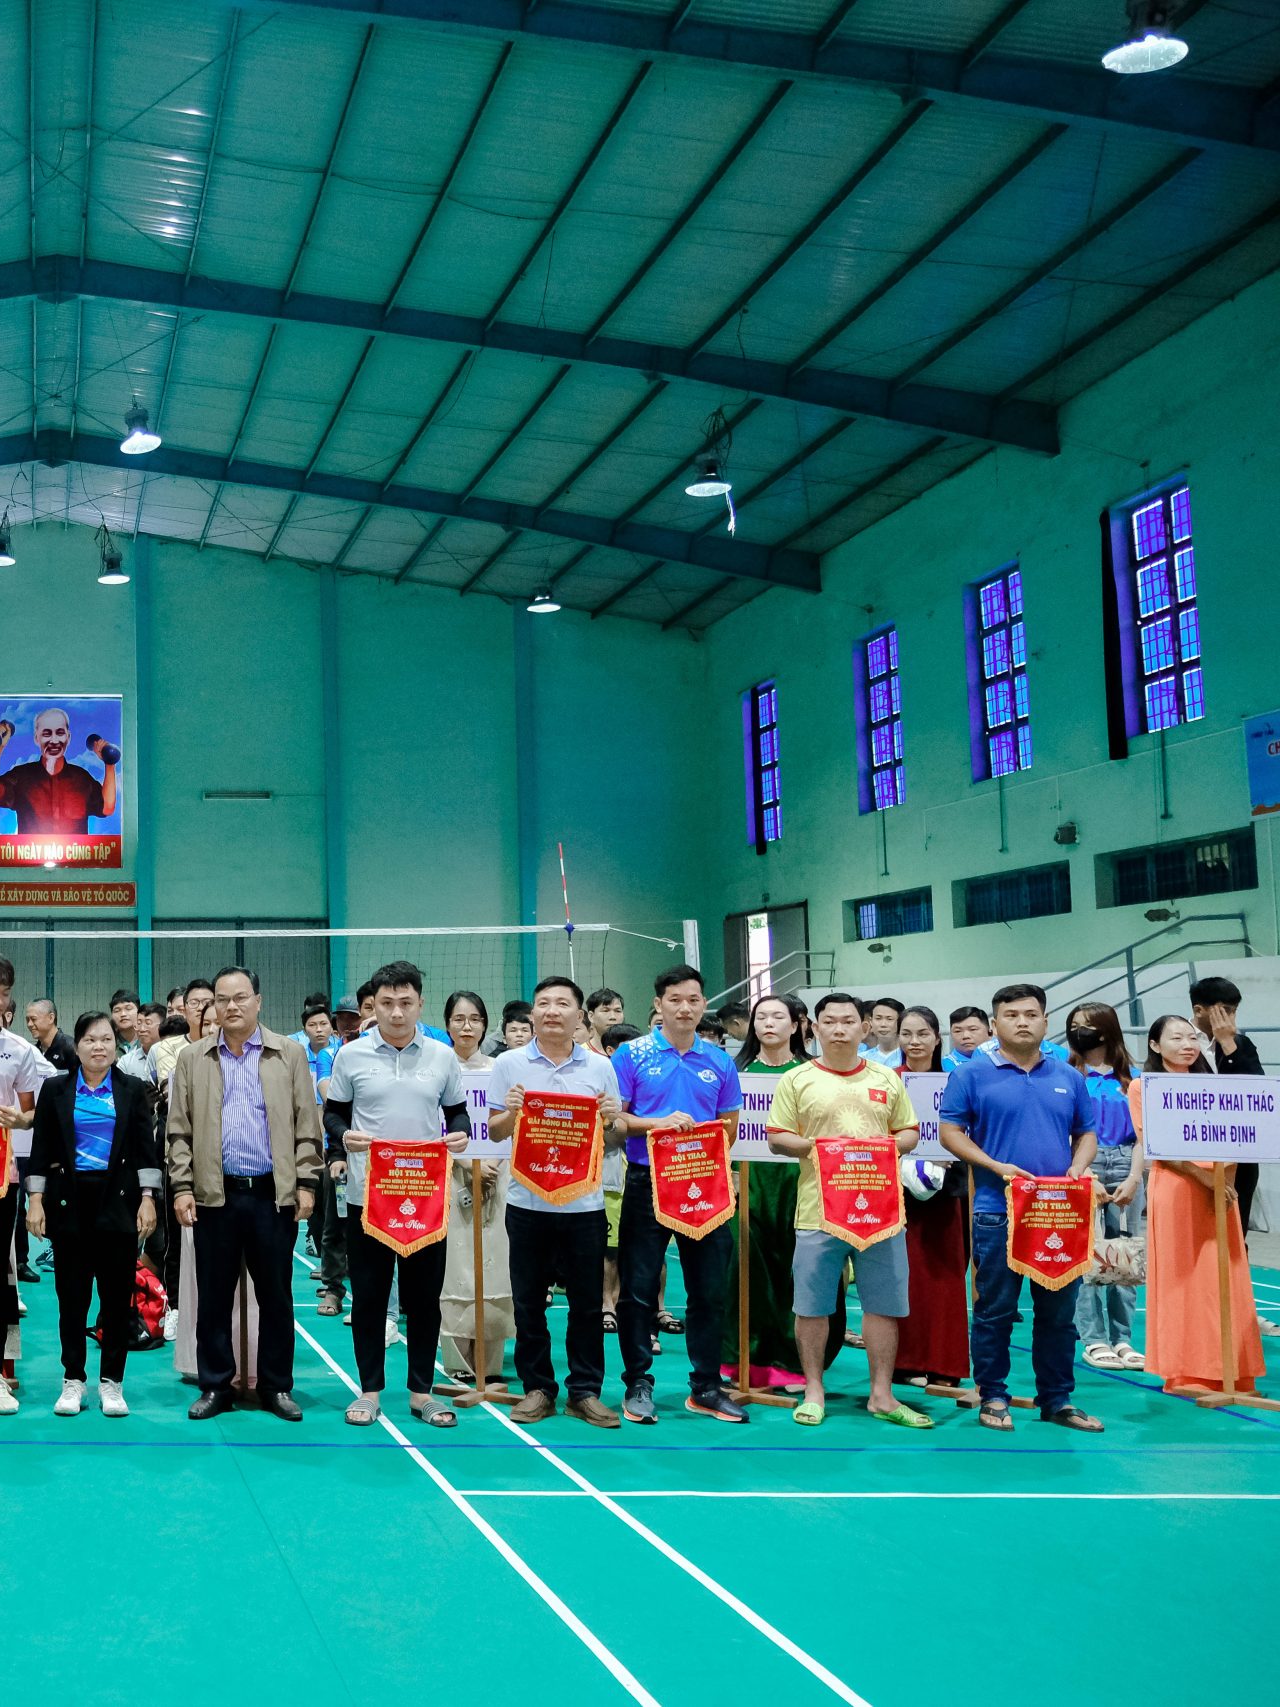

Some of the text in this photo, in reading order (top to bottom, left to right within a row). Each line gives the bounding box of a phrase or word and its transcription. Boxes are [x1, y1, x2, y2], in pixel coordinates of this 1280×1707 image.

[1, 842, 14, 860] TÔI
[17, 842, 41, 860] NGÀY
[66, 843, 91, 860] CŨNG
[8, 887, 24, 901] XÂY
[26, 889, 49, 904] DỰNG
[1162, 1088, 1274, 1115] XÍ NGHIỆP KHAI THÁC
[738, 1118, 768, 1141] BÌNH
[1183, 1120, 1256, 1147] ĐÁ BÌNH ĐỊNH
[388, 1168, 427, 1178] HỘI THAO
